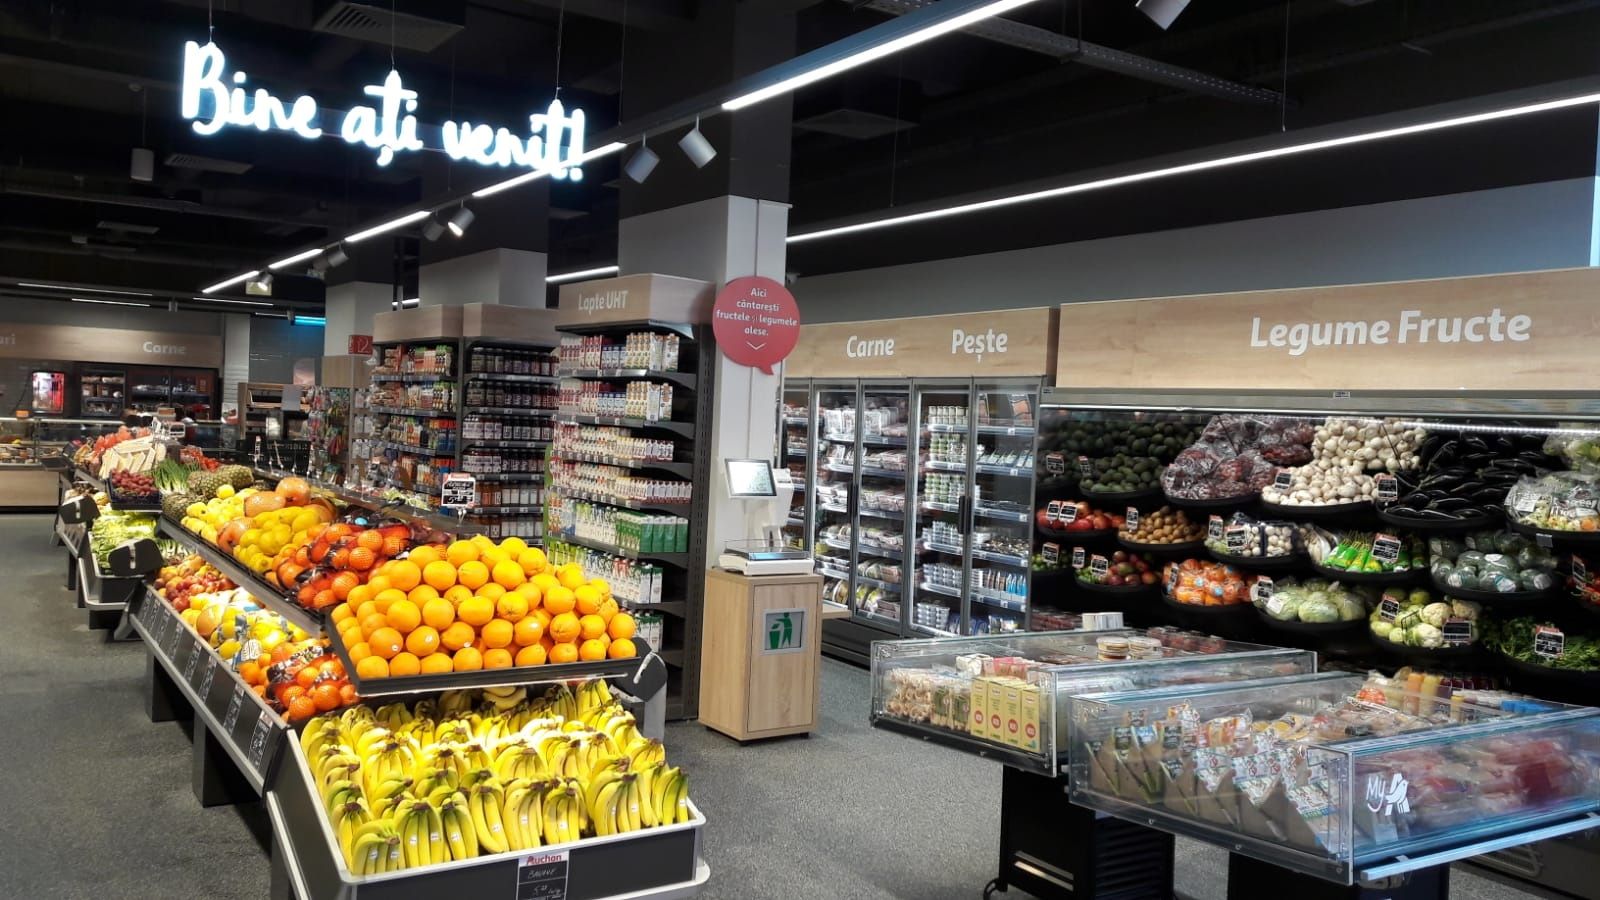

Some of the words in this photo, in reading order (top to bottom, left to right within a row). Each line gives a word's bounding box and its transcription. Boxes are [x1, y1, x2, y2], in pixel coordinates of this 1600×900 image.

[182, 40, 322, 137] Bine
[442, 98, 585, 181] venit!
[578, 293, 605, 316] Lapte
[606, 289, 629, 310] UHT
[750, 287, 768, 298] Aici
[716, 309, 751, 322] fructele
[760, 314, 798, 327] legumele
[744, 325, 769, 337] alese.
[1250, 317, 1391, 356] Legume
[1397, 308, 1532, 344] Fructe
[142, 341, 187, 355] Carne
[846, 335, 895, 358] Carne
[951, 328, 1008, 363] Pește
[1366, 775, 1386, 813] My
[526, 854, 562, 866] Auchan
